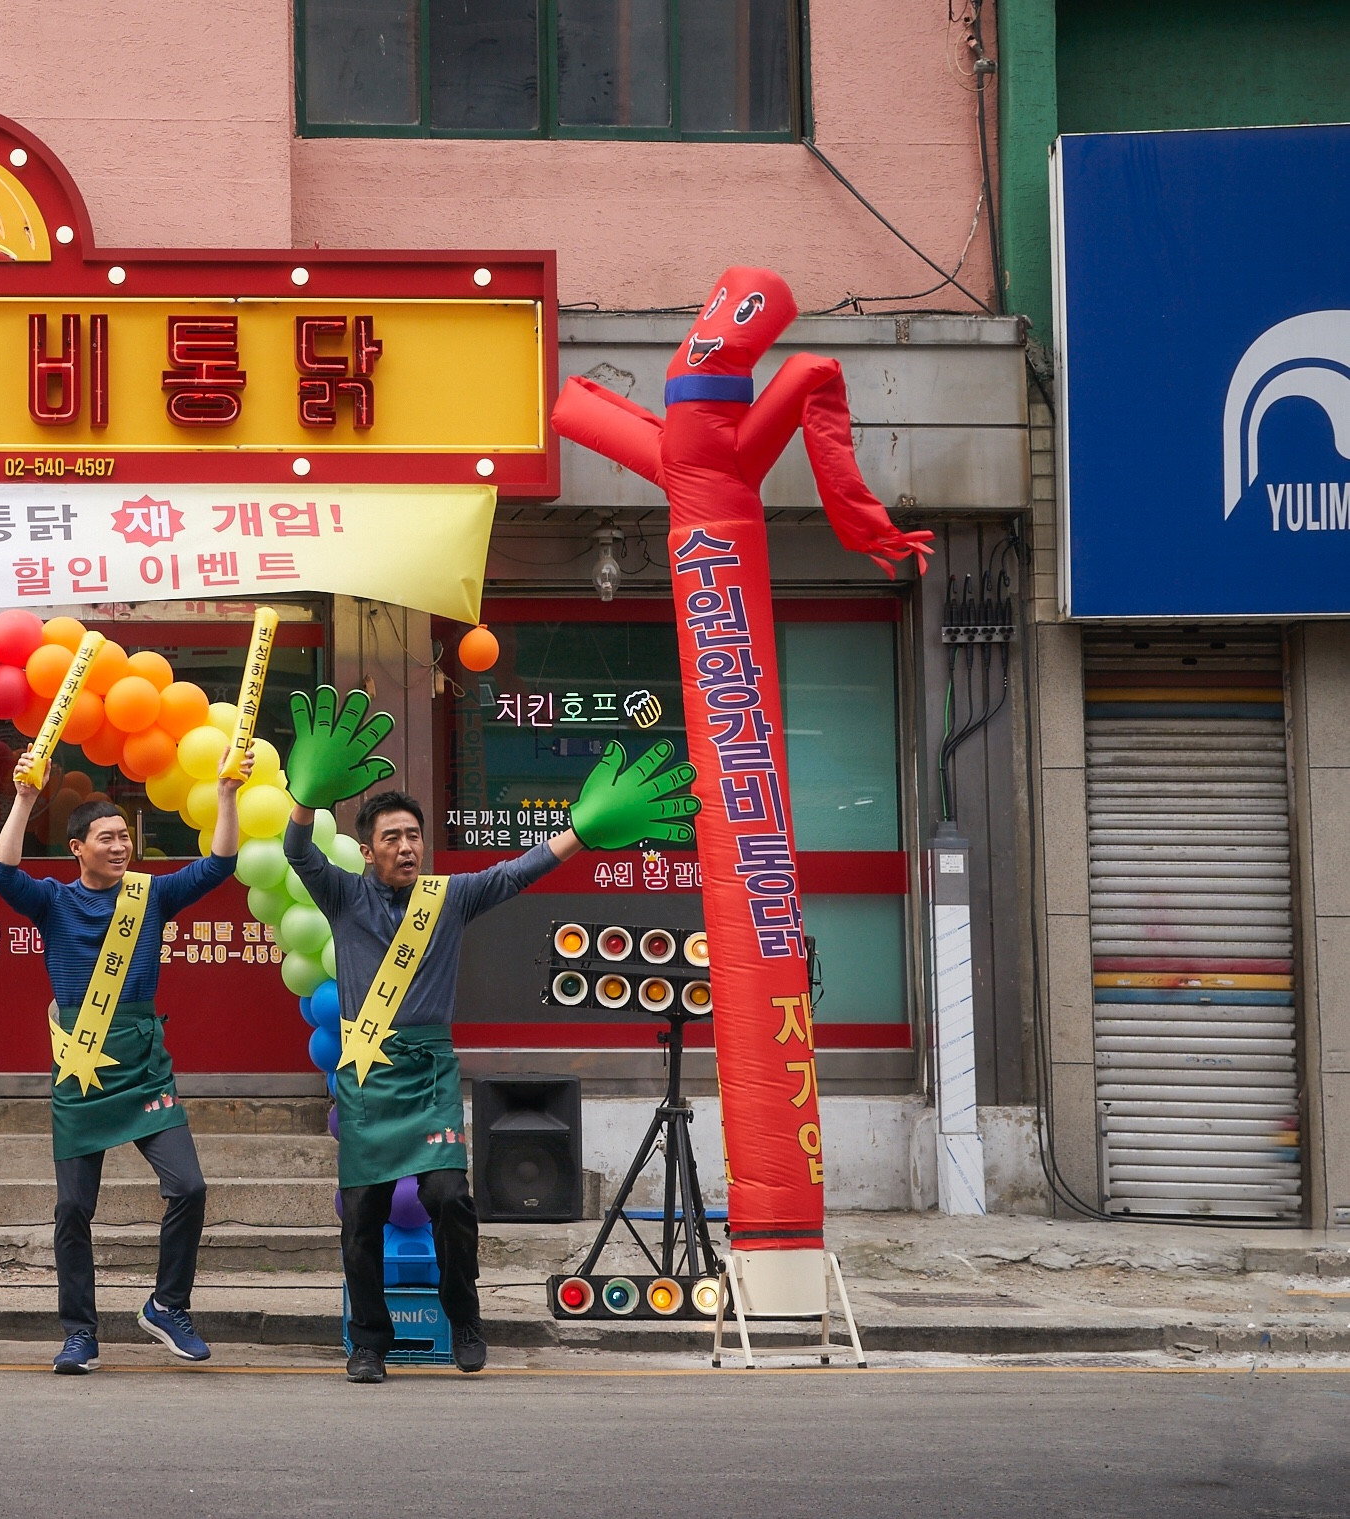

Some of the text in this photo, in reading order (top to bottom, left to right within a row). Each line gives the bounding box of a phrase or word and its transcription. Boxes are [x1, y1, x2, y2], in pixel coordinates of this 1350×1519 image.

[4, 458, 115, 476] 02-540-4597
[124, 506, 172, 538] 재
[212, 501, 345, 538] 개업!
[1266, 482, 1350, 532] YULIM
[12, 555, 109, 597] 할인
[139, 551, 301, 590] 이벤트
[235, 626, 272, 753] 반성하겠습니다
[446, 810, 571, 826] 지금까지 이런맛
[465, 830, 511, 846] 이것은
[594, 862, 633, 887] 수원
[643, 857, 669, 890] 왕
[77, 882, 143, 1054] 반성합니다
[359, 879, 441, 1043] 반성합니다
